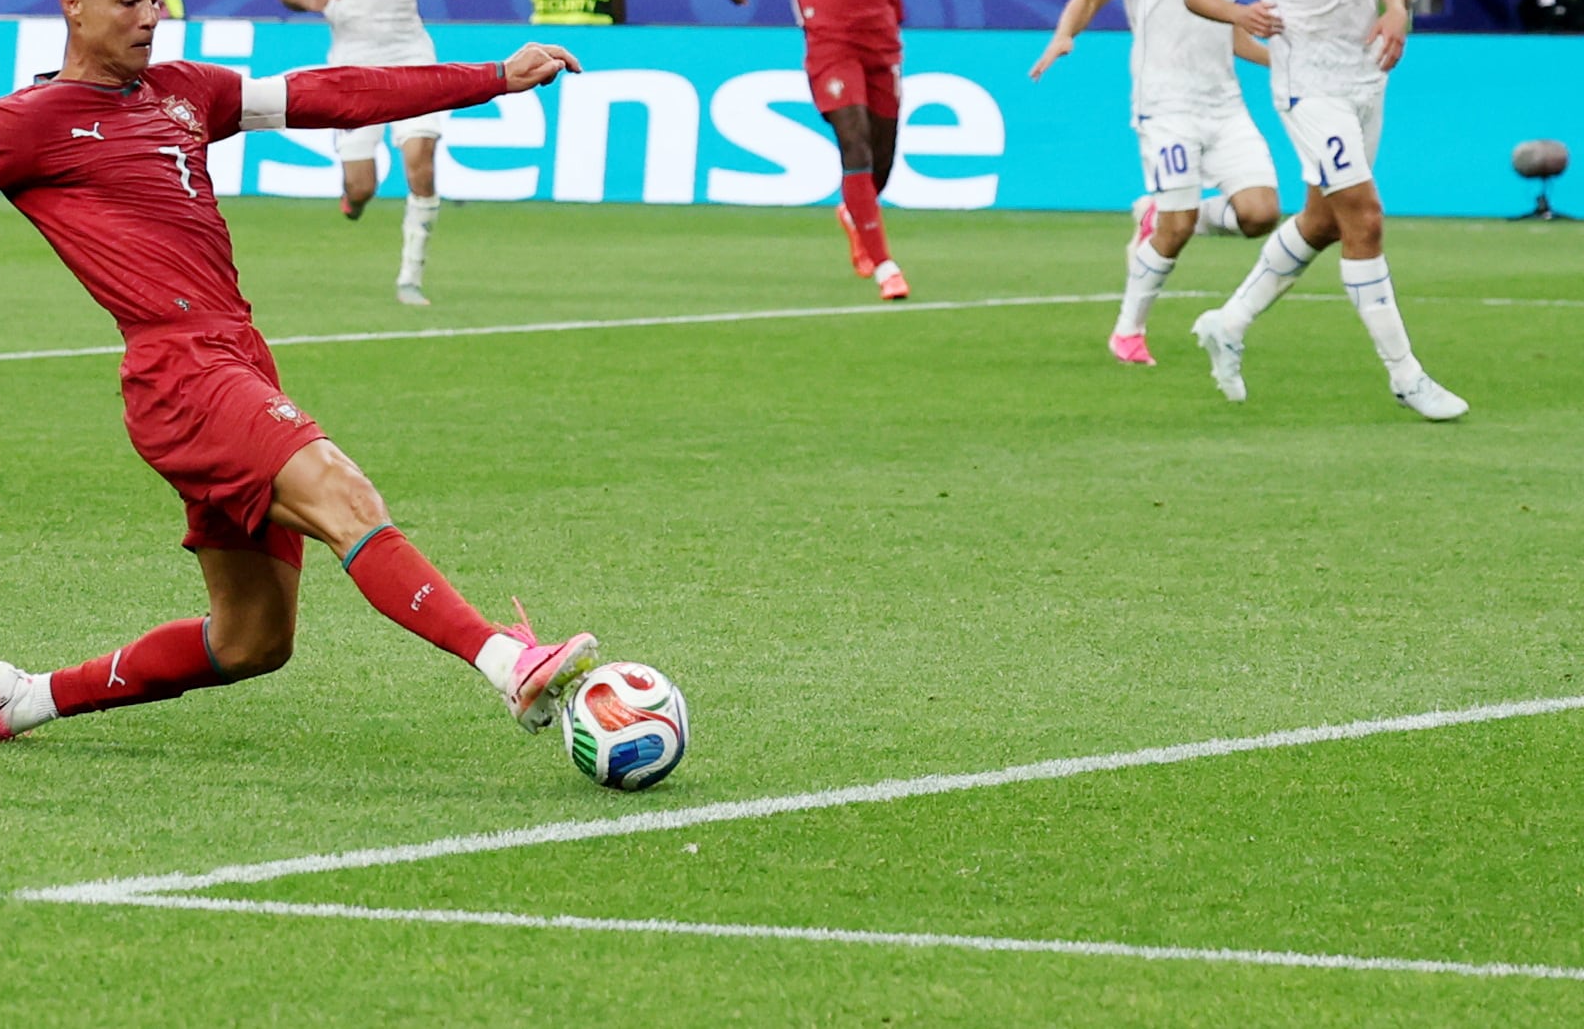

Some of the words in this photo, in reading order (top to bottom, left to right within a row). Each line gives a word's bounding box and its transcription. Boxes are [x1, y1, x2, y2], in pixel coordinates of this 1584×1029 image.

[1159, 143, 1188, 175] 10
[1326, 135, 1351, 171] 2
[157, 144, 198, 199] 7
